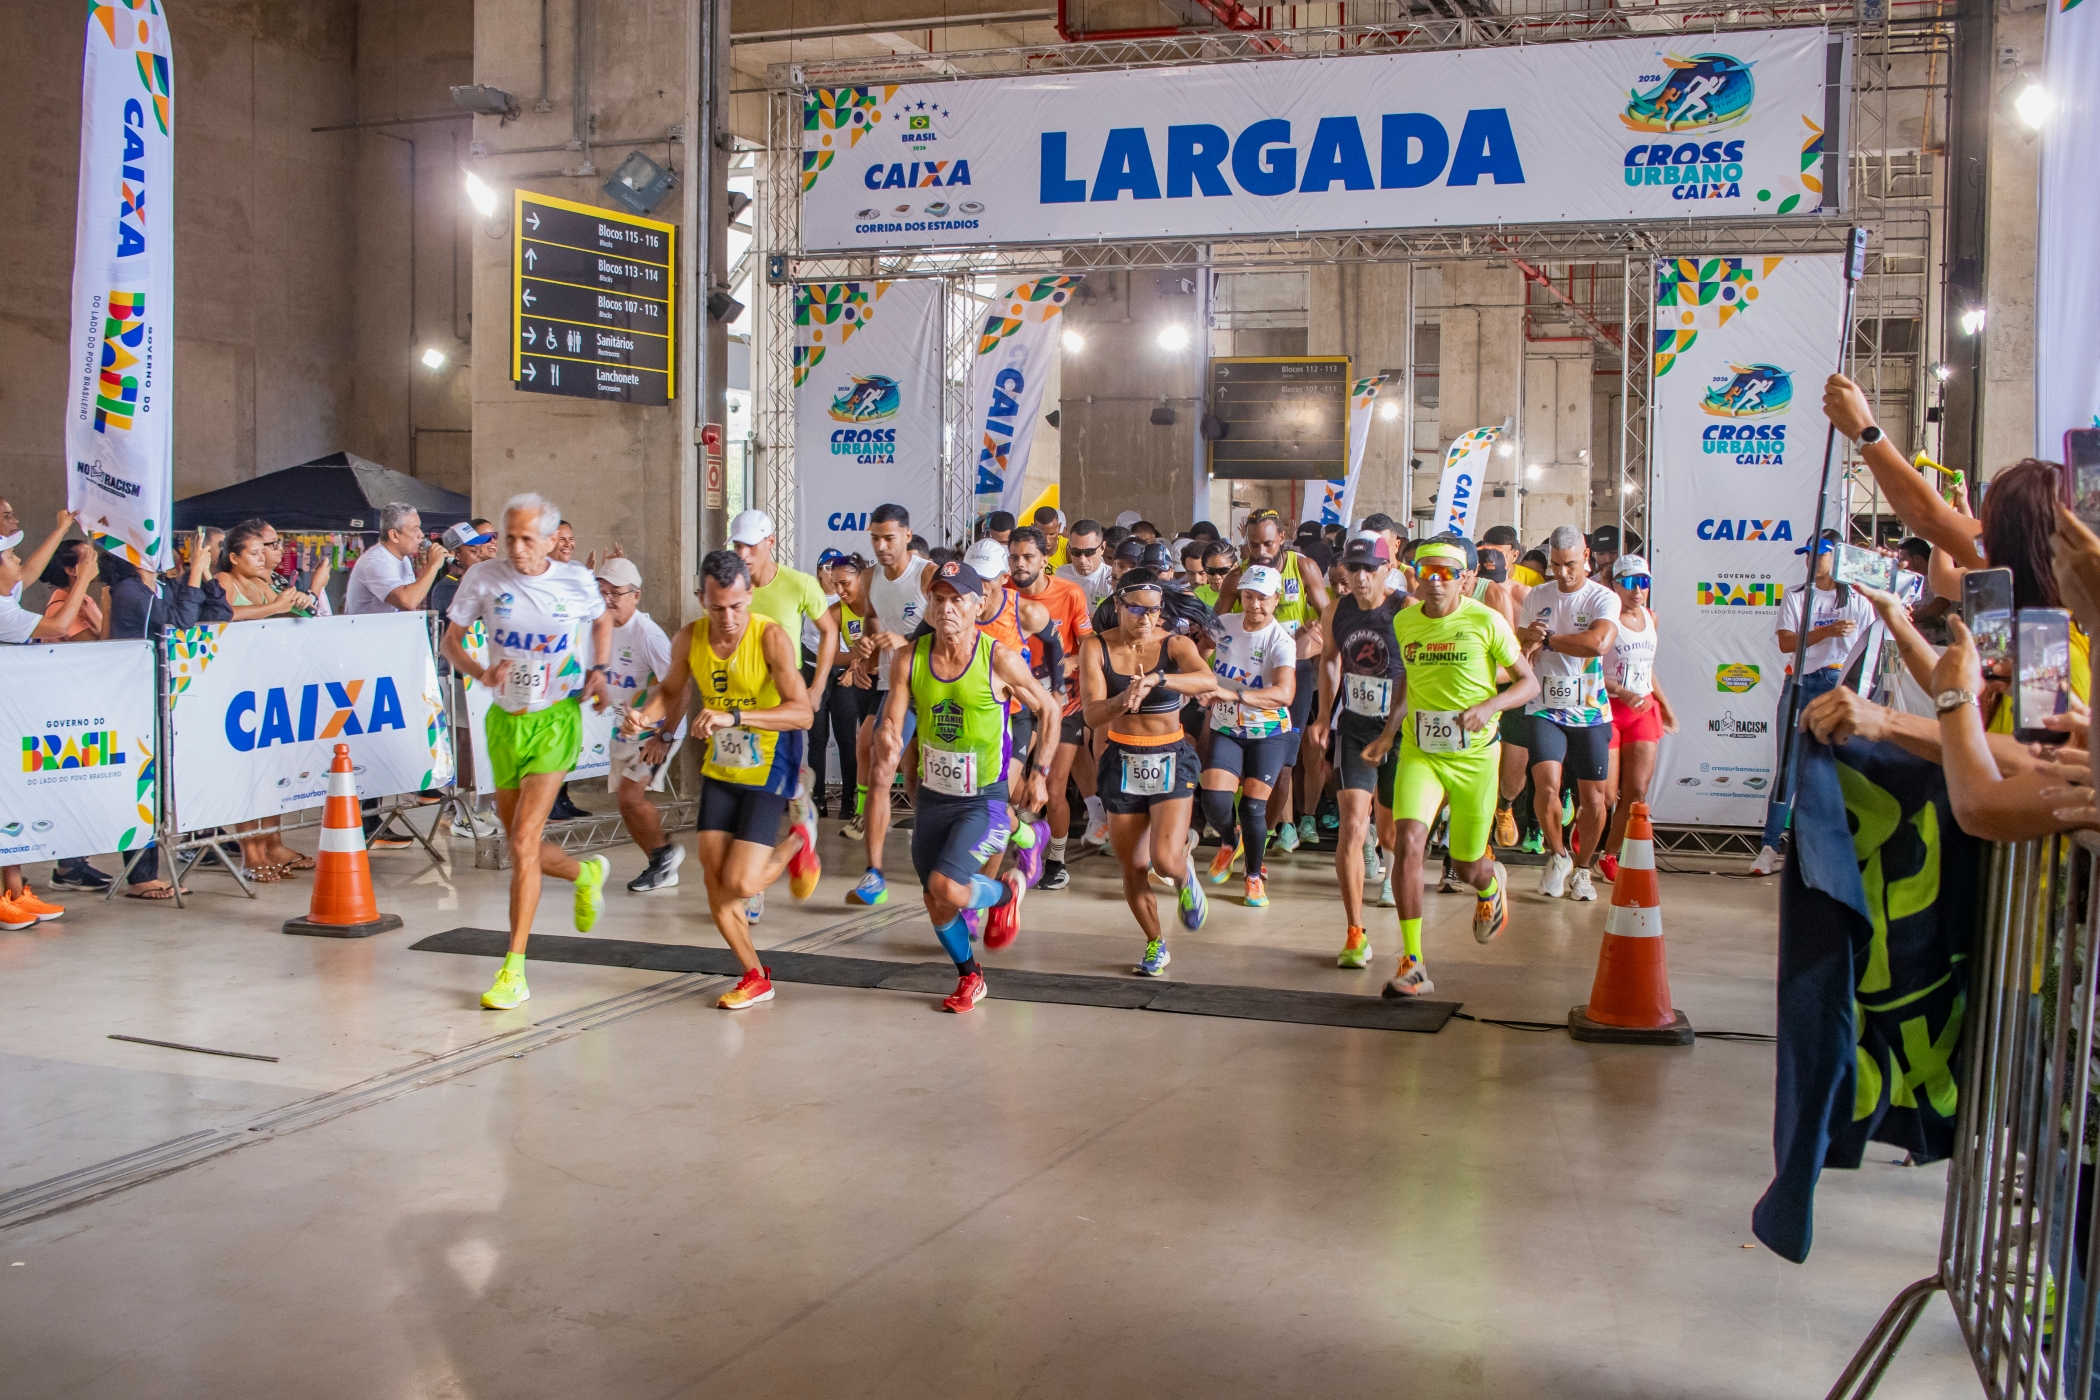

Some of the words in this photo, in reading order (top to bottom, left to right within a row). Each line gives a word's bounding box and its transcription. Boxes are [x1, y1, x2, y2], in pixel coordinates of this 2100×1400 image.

[1638, 74, 1661, 82] 2026
[901, 132, 937, 142] BRASIL
[1040, 107, 1525, 204] LARGADA
[1624, 140, 1745, 166] CROSS
[117, 98, 145, 258] CAIXA
[864, 159, 971, 190] CAIXA
[1624, 163, 1743, 187] URBANO
[1672, 182, 1741, 200] CAIXA
[855, 222, 903, 234] CORRIDA
[904, 221, 926, 232] DOS
[927, 219, 979, 231] ESTADIOS
[598, 224, 623, 241] Blocos
[625, 230, 639, 244] 115
[646, 234, 659, 248] 116
[599, 239, 613, 249] Blocks
[598, 259, 623, 275] Blocos
[625, 264, 638, 278] 113
[645, 269, 659, 282] 114
[599, 274, 613, 284] Blocks
[93, 295, 101, 308] DO
[598, 295, 623, 311] Blocos
[624, 300, 638, 314] 107
[645, 304, 658, 317] 112
[89, 311, 98, 333] LADO
[599, 311, 613, 320] Blocks
[87, 336, 95, 349] DO
[596, 333, 634, 350] Sanitários
[145, 327, 153, 388] GOVERNO
[598, 349, 620, 358] Restrooms
[84, 351, 94, 374] POVO
[94, 290, 145, 434] BRASIL
[1306, 365, 1318, 373] 112
[1325, 365, 1337, 373] 113
[596, 369, 639, 385] Lanchonete
[597, 384, 621, 393] Concession
[79, 377, 92, 421] BRASILEIRO
[143, 396, 150, 413] DO
[831, 428, 897, 443] CROSS
[975, 368, 1024, 495] CAIXA
[1702, 424, 1786, 440] CROSS
[831, 442, 896, 455] URBANO
[1702, 440, 1785, 454] URBANO
[857, 454, 894, 465] CAIXA
[1735, 454, 1783, 465] CAIXA
[77, 461, 90, 475] NO
[104, 473, 141, 497] RACISM
[1448, 473, 1473, 537] CAIXA
[827, 512, 873, 531] CAI
[1696, 518, 1793, 542] CAIXA
[1697, 582, 1784, 606] BRASIL
[494, 628, 569, 654] CAIXA
[1344, 630, 1385, 649] ROMERO
[1426, 642, 1456, 652] AVANTI
[1419, 652, 1467, 661] RUNNING
[1213, 659, 1264, 689] CAIXA
[1352, 687, 1375, 702] 836
[1550, 686, 1571, 697] 669
[225, 675, 406, 753] CAIXA
[1216, 702, 1235, 715] 1314
[46, 718, 89, 728] GOVERNO
[94, 718, 105, 726] DO
[1708, 720, 1720, 732] NO
[1736, 721, 1768, 733] RACISM
[1424, 725, 1452, 738] 720
[22, 731, 126, 773] BRASIL
[27, 778, 37, 786] DO
[39, 776, 57, 785] LADO
[59, 775, 69, 783] DO
[70, 774, 88, 782] POVO
[89, 771, 122, 780] BRASILEIRO
[929, 761, 962, 780] 1206
[1133, 767, 1160, 780] 500
